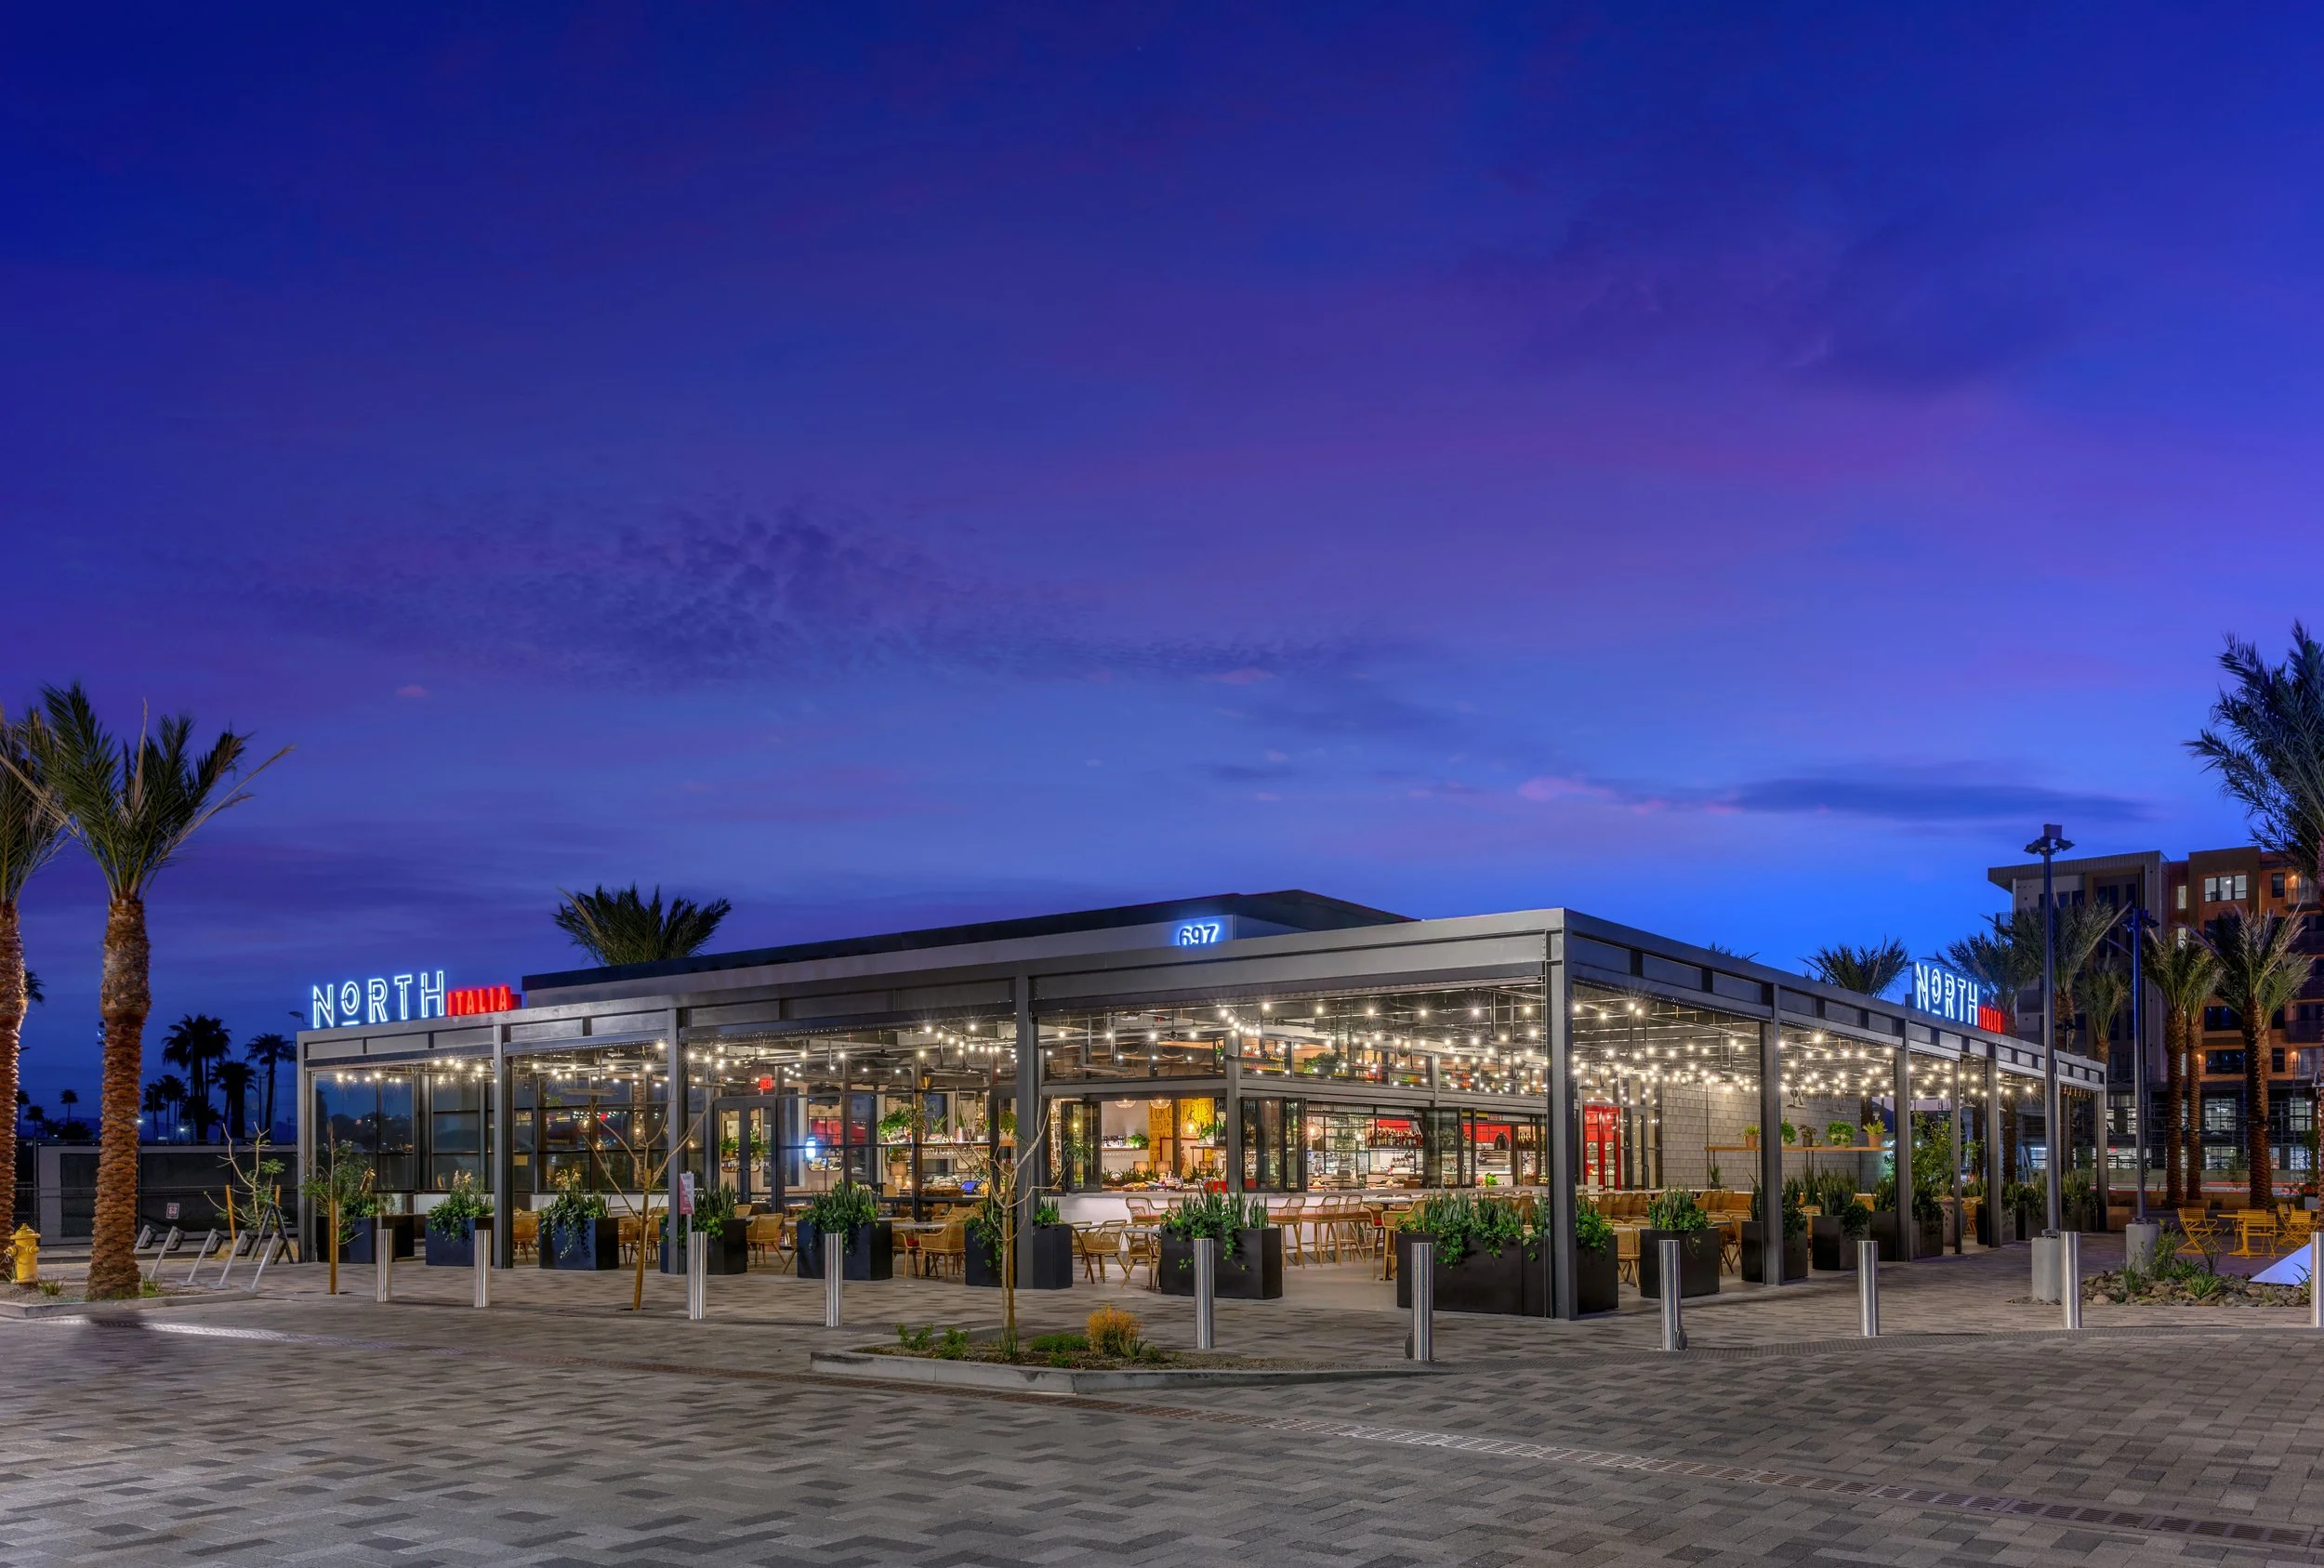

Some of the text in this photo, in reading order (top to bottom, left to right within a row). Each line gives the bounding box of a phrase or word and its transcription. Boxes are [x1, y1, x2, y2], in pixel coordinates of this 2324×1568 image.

[1179, 925, 1217, 946] 697
[312, 970, 510, 1029] NORTH ITALIA
[1915, 961, 2002, 1034] NORTH ITALIA
